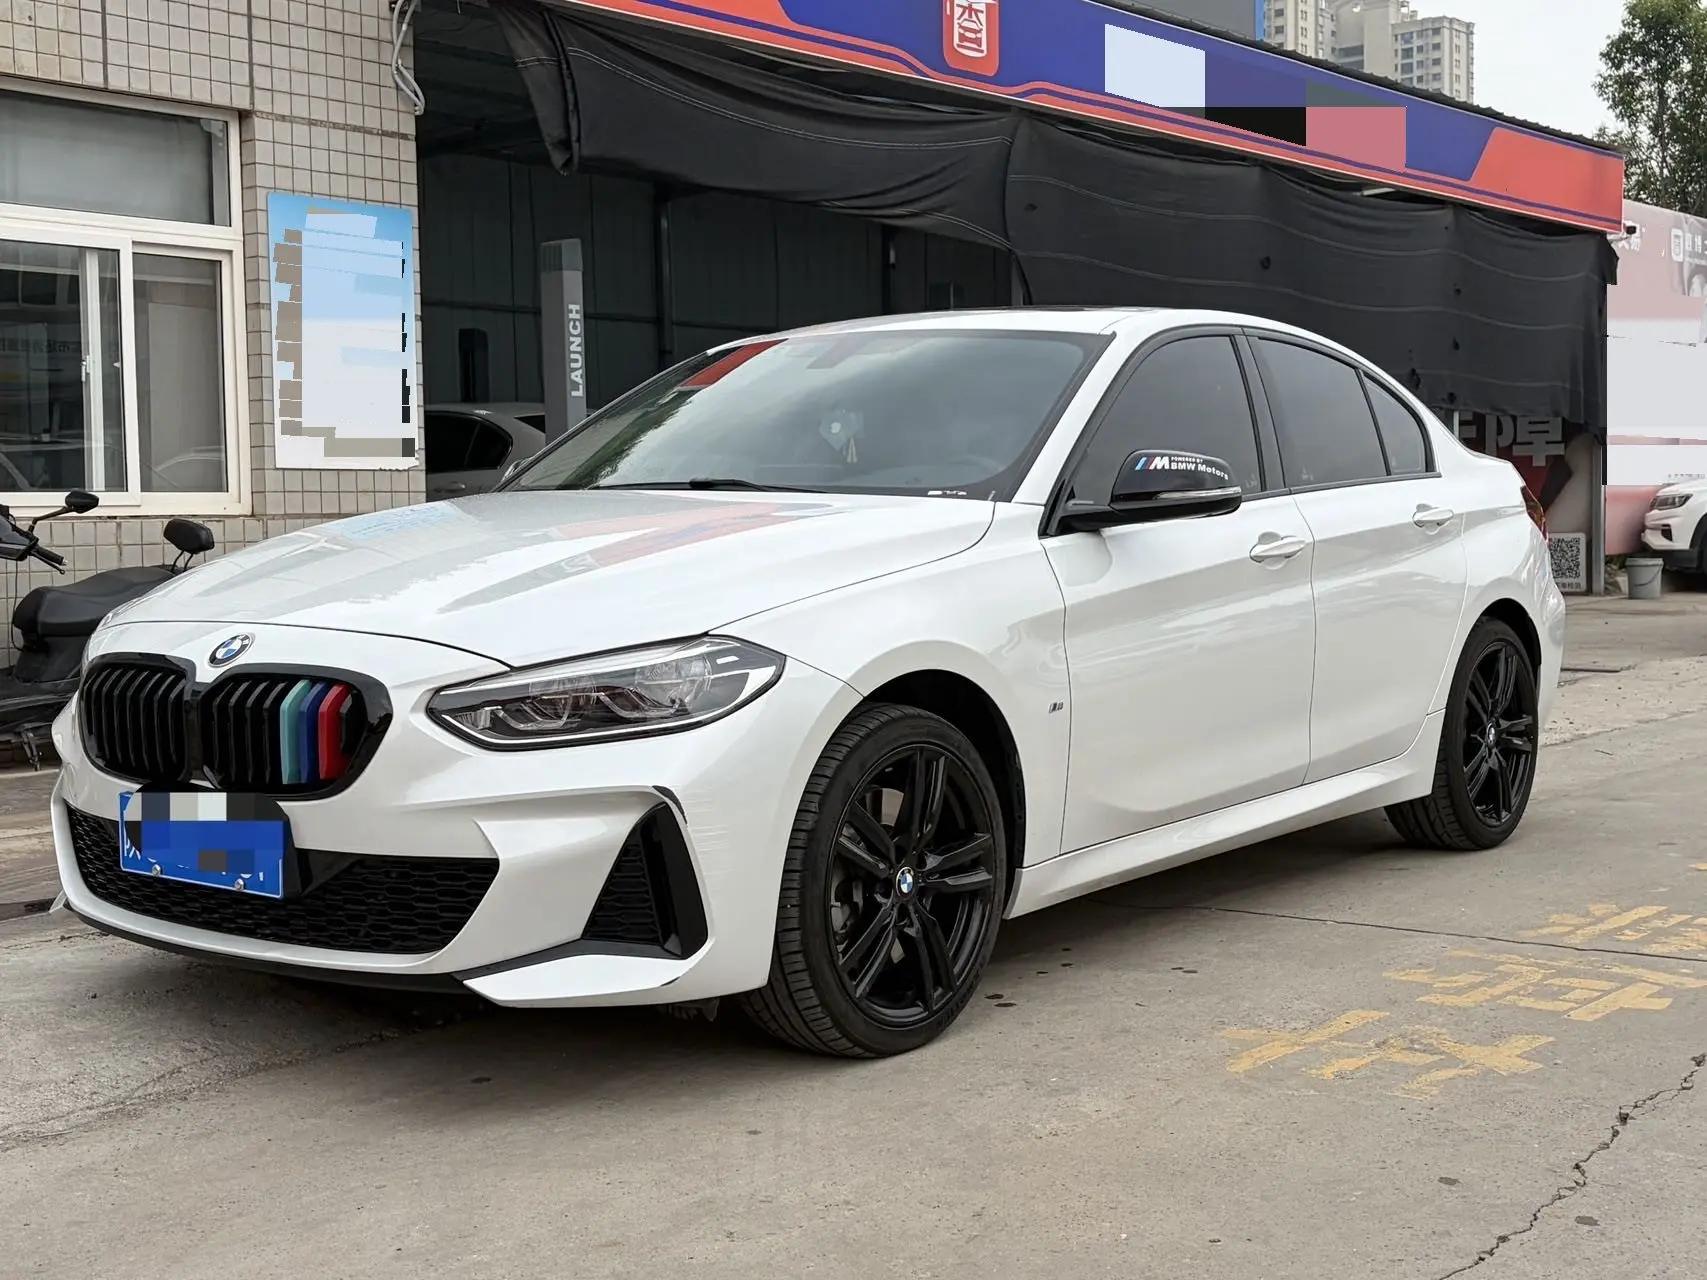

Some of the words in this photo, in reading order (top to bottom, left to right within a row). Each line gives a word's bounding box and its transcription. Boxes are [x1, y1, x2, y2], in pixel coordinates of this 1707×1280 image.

[568, 303, 584, 397] LAUNCH
[1170, 462, 1196, 471] BMW
[1197, 463, 1229, 480] Motors
